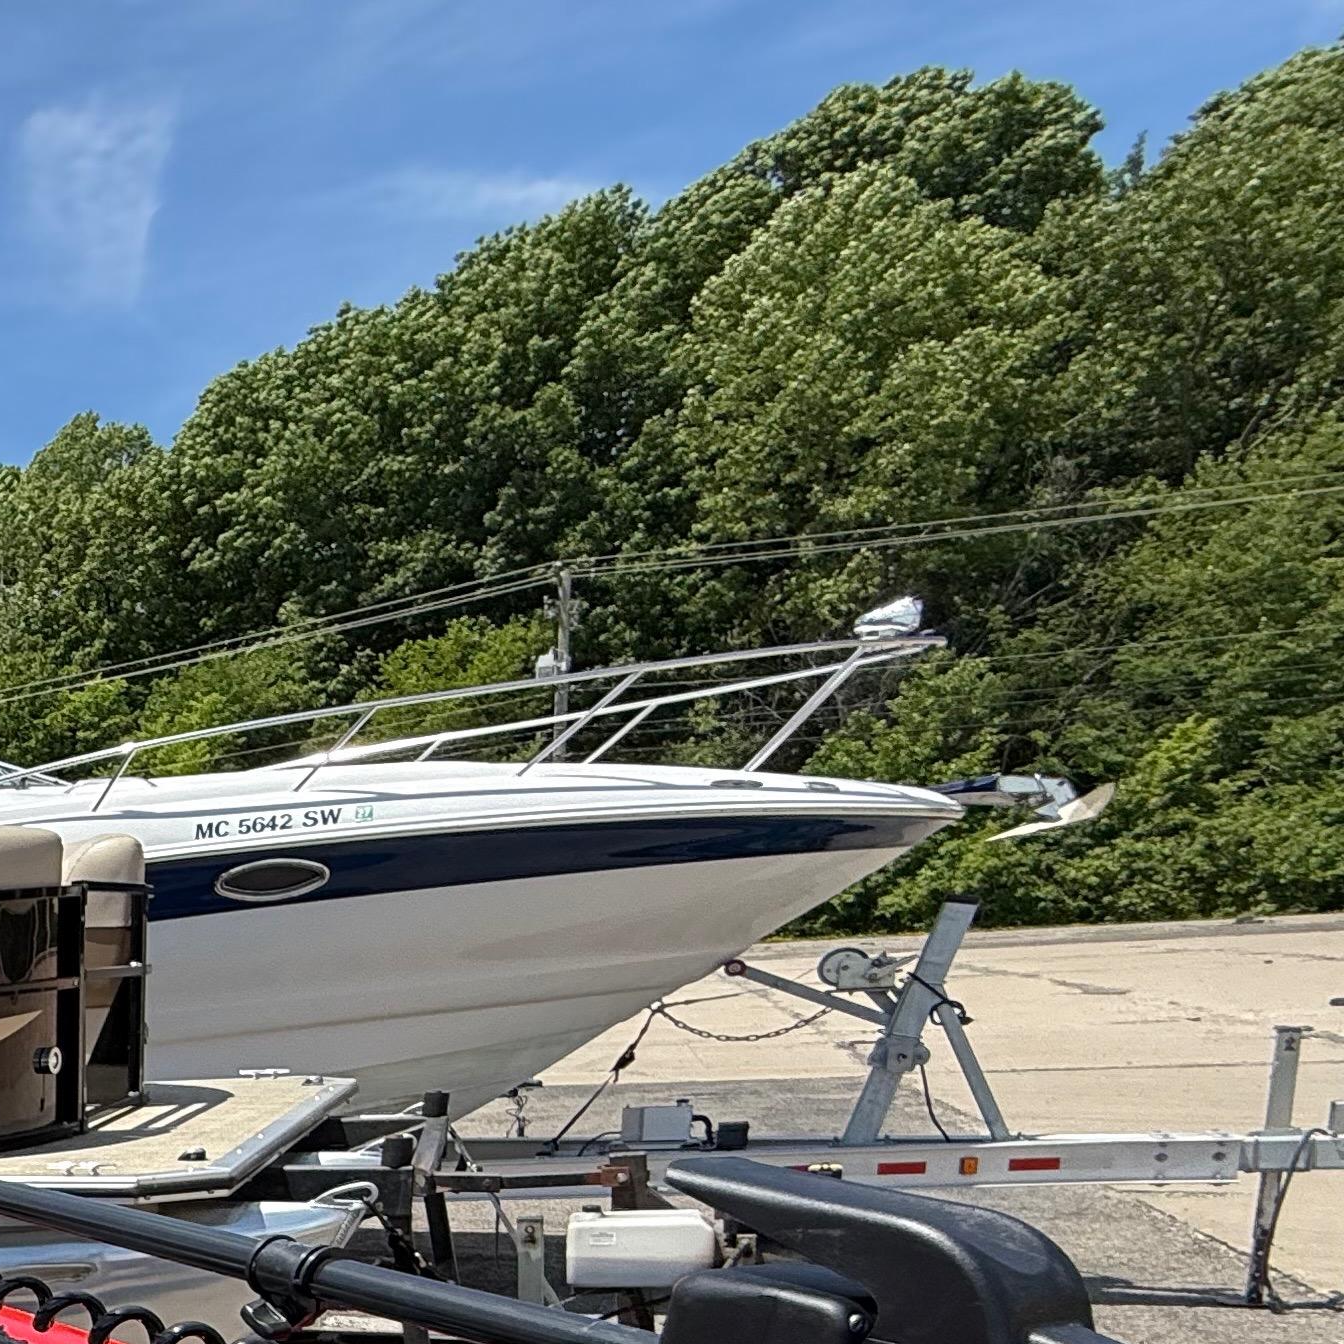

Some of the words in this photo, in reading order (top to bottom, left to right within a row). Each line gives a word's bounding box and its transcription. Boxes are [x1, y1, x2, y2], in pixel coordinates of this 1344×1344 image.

[194, 820, 230, 840] MC
[238, 813, 293, 835] 5642
[302, 807, 343, 828] SW
